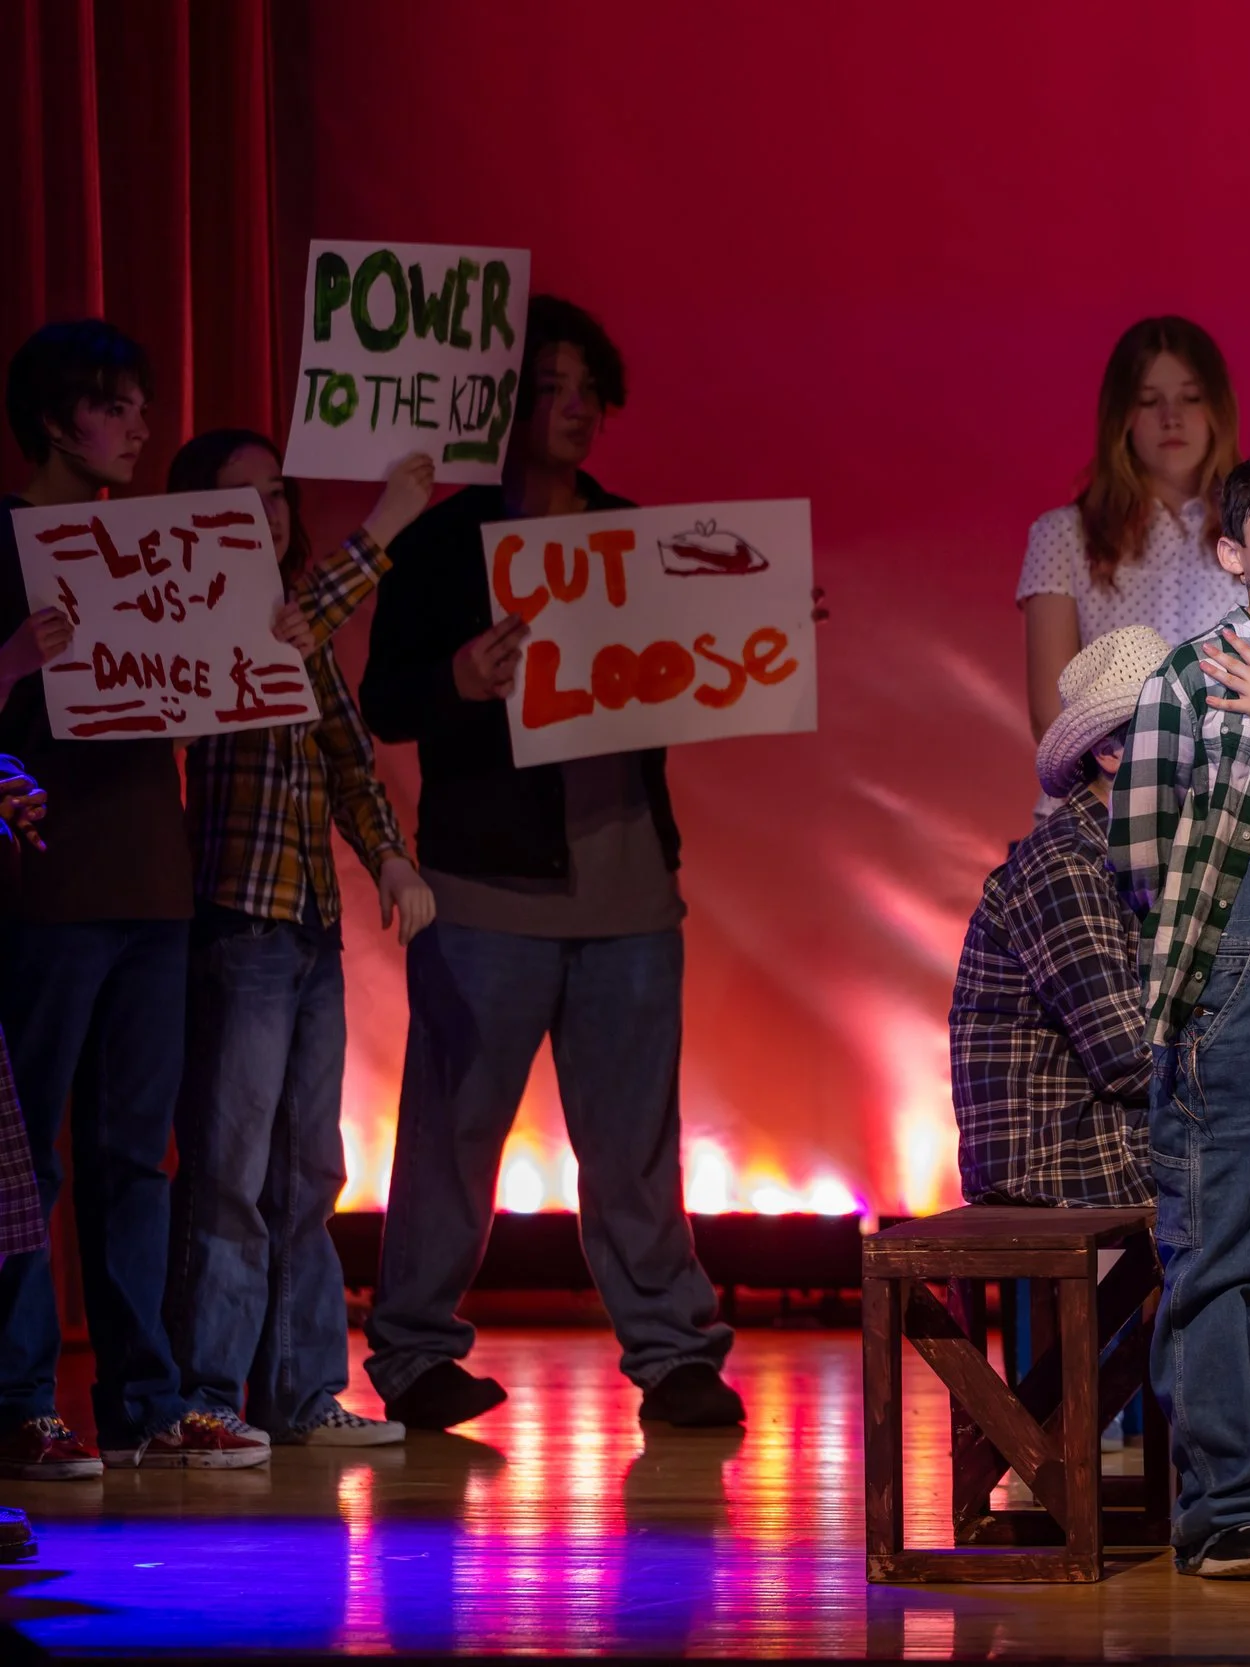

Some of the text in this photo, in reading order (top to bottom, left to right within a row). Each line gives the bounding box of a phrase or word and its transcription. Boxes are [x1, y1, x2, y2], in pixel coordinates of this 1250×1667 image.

[314, 249, 515, 353] POWER
[304, 368, 518, 444] TO THE KIDS
[90, 515, 199, 579] LET
[492, 529, 636, 625] CUT
[92, 642, 212, 699] DANCE
